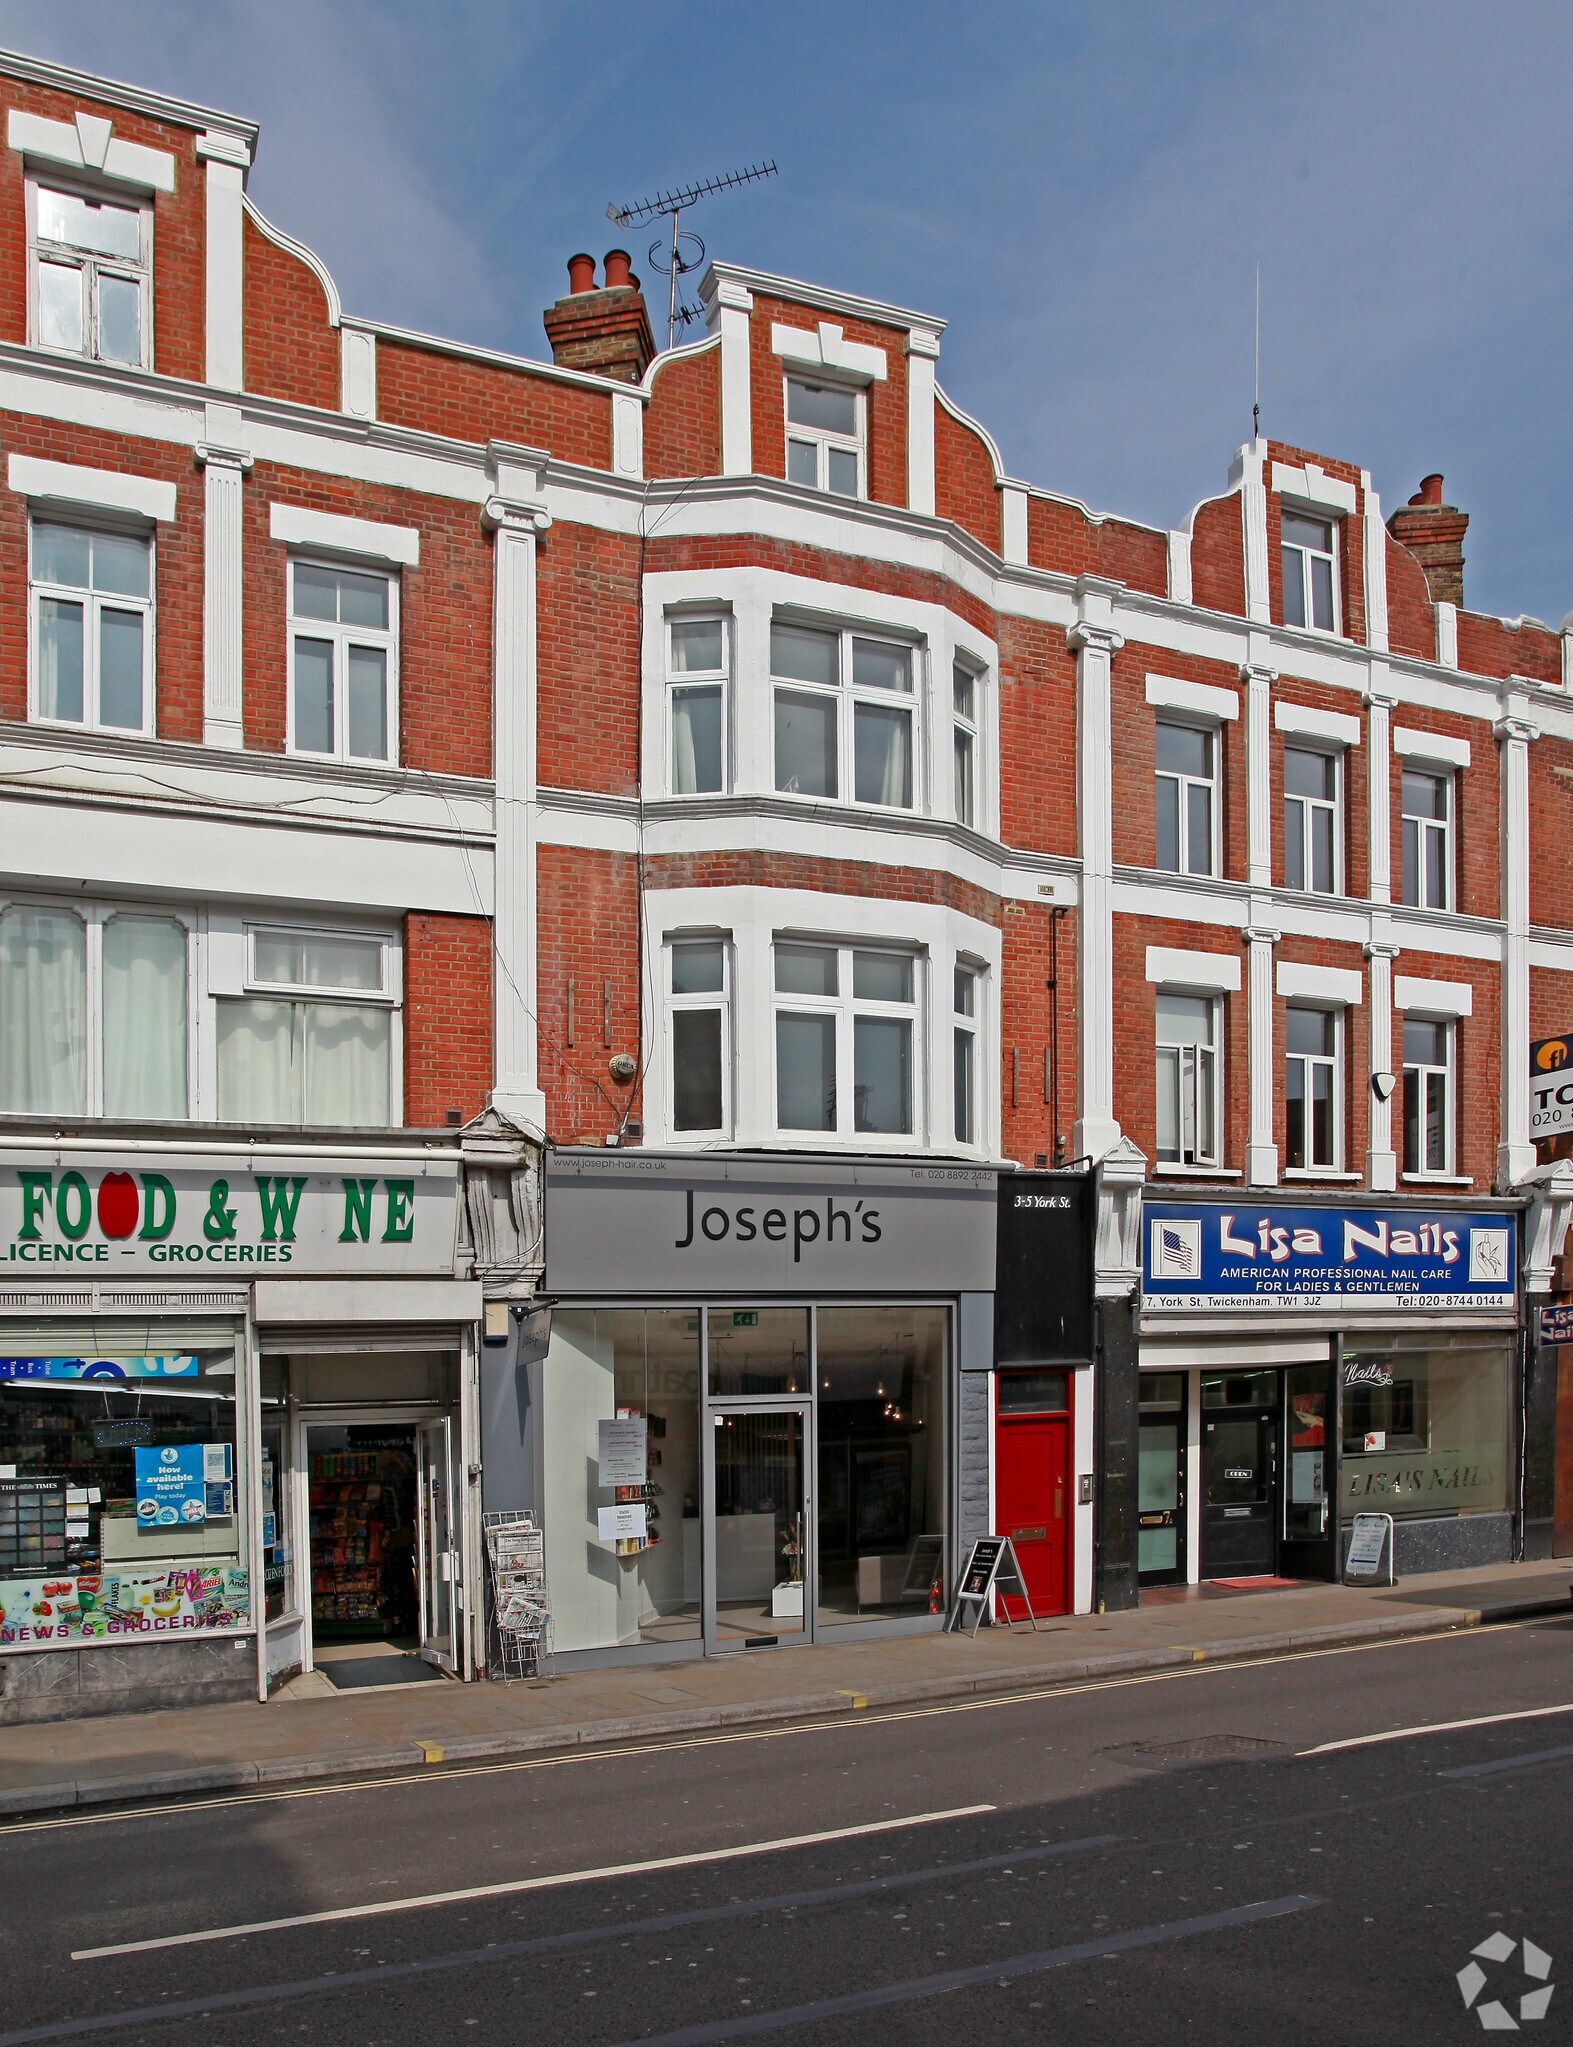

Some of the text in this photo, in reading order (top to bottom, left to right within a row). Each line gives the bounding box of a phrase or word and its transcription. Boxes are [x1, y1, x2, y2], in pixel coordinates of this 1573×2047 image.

[1532, 1109, 1562, 1127] 020
[553, 1158, 666, 1170] www.joseph-hair.co.uk
[911, 1169, 993, 1181] Tel: 020 8892 2442
[1014, 1195, 1071, 1209] 3-5 York St.
[203, 1178, 239, 1241] &
[675, 1189, 882, 1263] Joseph's
[1219, 1213, 1461, 1265] Lisa Nails
[148, 1243, 293, 1263] GROCERIES
[1220, 1267, 1452, 1279] AMERICAN PROFESSIONAL NAIL CARE
[1256, 1281, 1420, 1292] FOR LADIES & GENTLEMEN
[1160, 1296, 1183, 1307] York
[1189, 1296, 1203, 1308] St,
[1277, 1297, 1297, 1306] TW1
[1304, 1297, 1321, 1306] 3JZ
[1476, 1296, 1503, 1306] 0144
[521, 1327, 547, 1349] Joseph's
[1344, 1362, 1382, 1383] Nails
[158, 1466, 181, 1474] Now
[146, 1474, 193, 1483] available
[1349, 1464, 1496, 1497] LISA'S NAILS
[156, 1482, 184, 1491] here!
[202, 1576, 221, 1588] ARIEL
[0, 1612, 232, 1642] NEWS & GROCERIES
